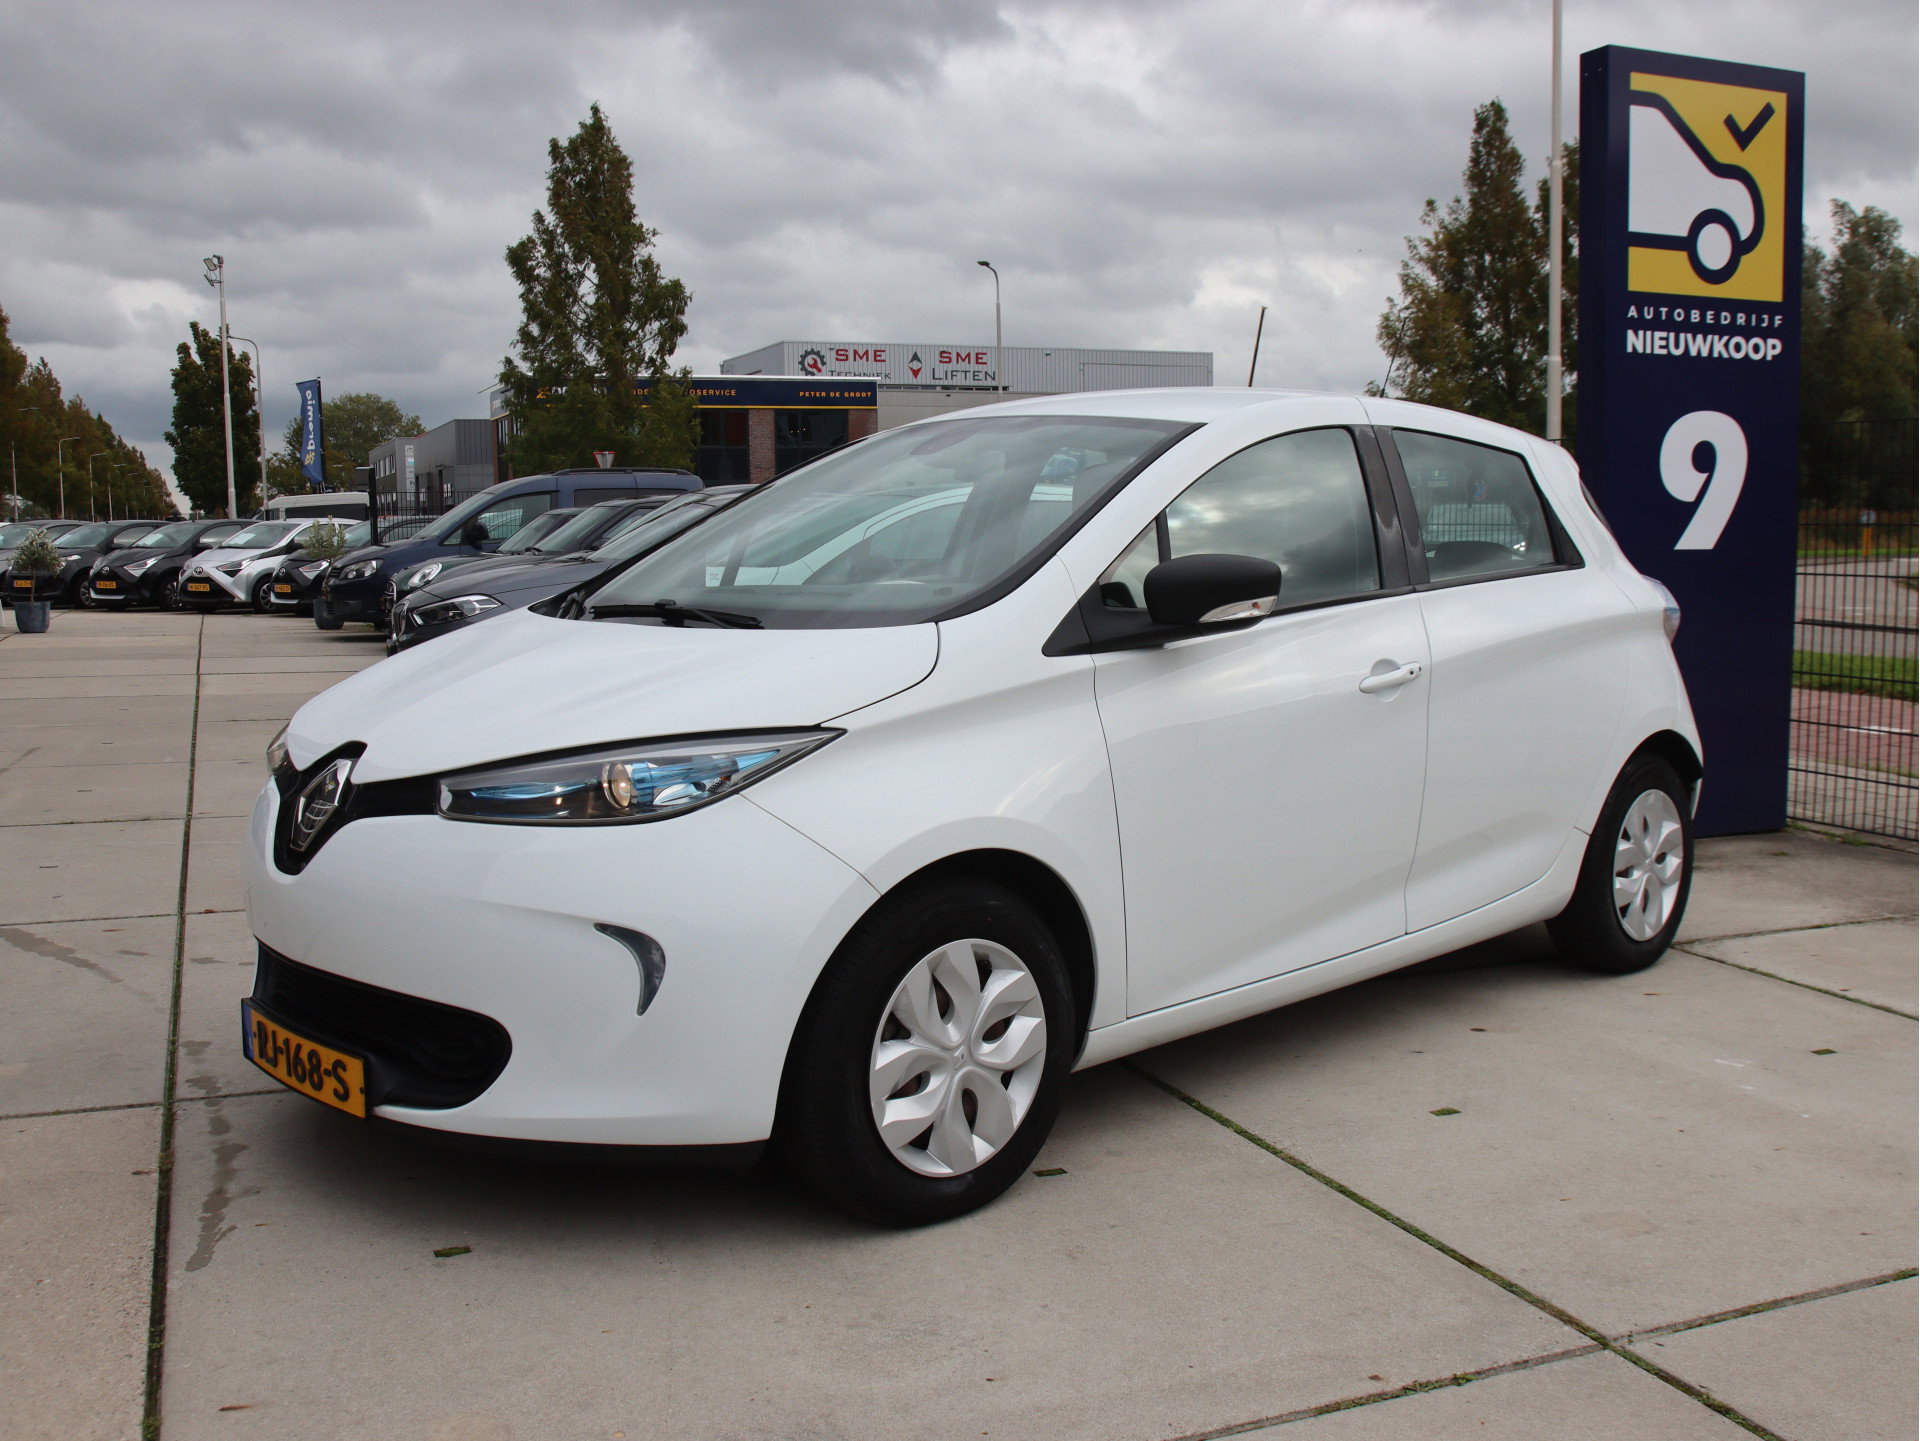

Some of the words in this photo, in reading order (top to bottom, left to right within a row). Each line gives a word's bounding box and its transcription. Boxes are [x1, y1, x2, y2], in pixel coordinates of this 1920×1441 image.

[1627, 305, 1783, 328] AUTOBEDRIJF
[834, 348, 886, 363] SME
[1626, 329, 1782, 361] NIEUWKOOP
[938, 351, 988, 365] SME
[932, 367, 996, 381] LIFTEN
[1659, 410, 1748, 550] 9
[256, 1020, 350, 1102] RJ-168-S
